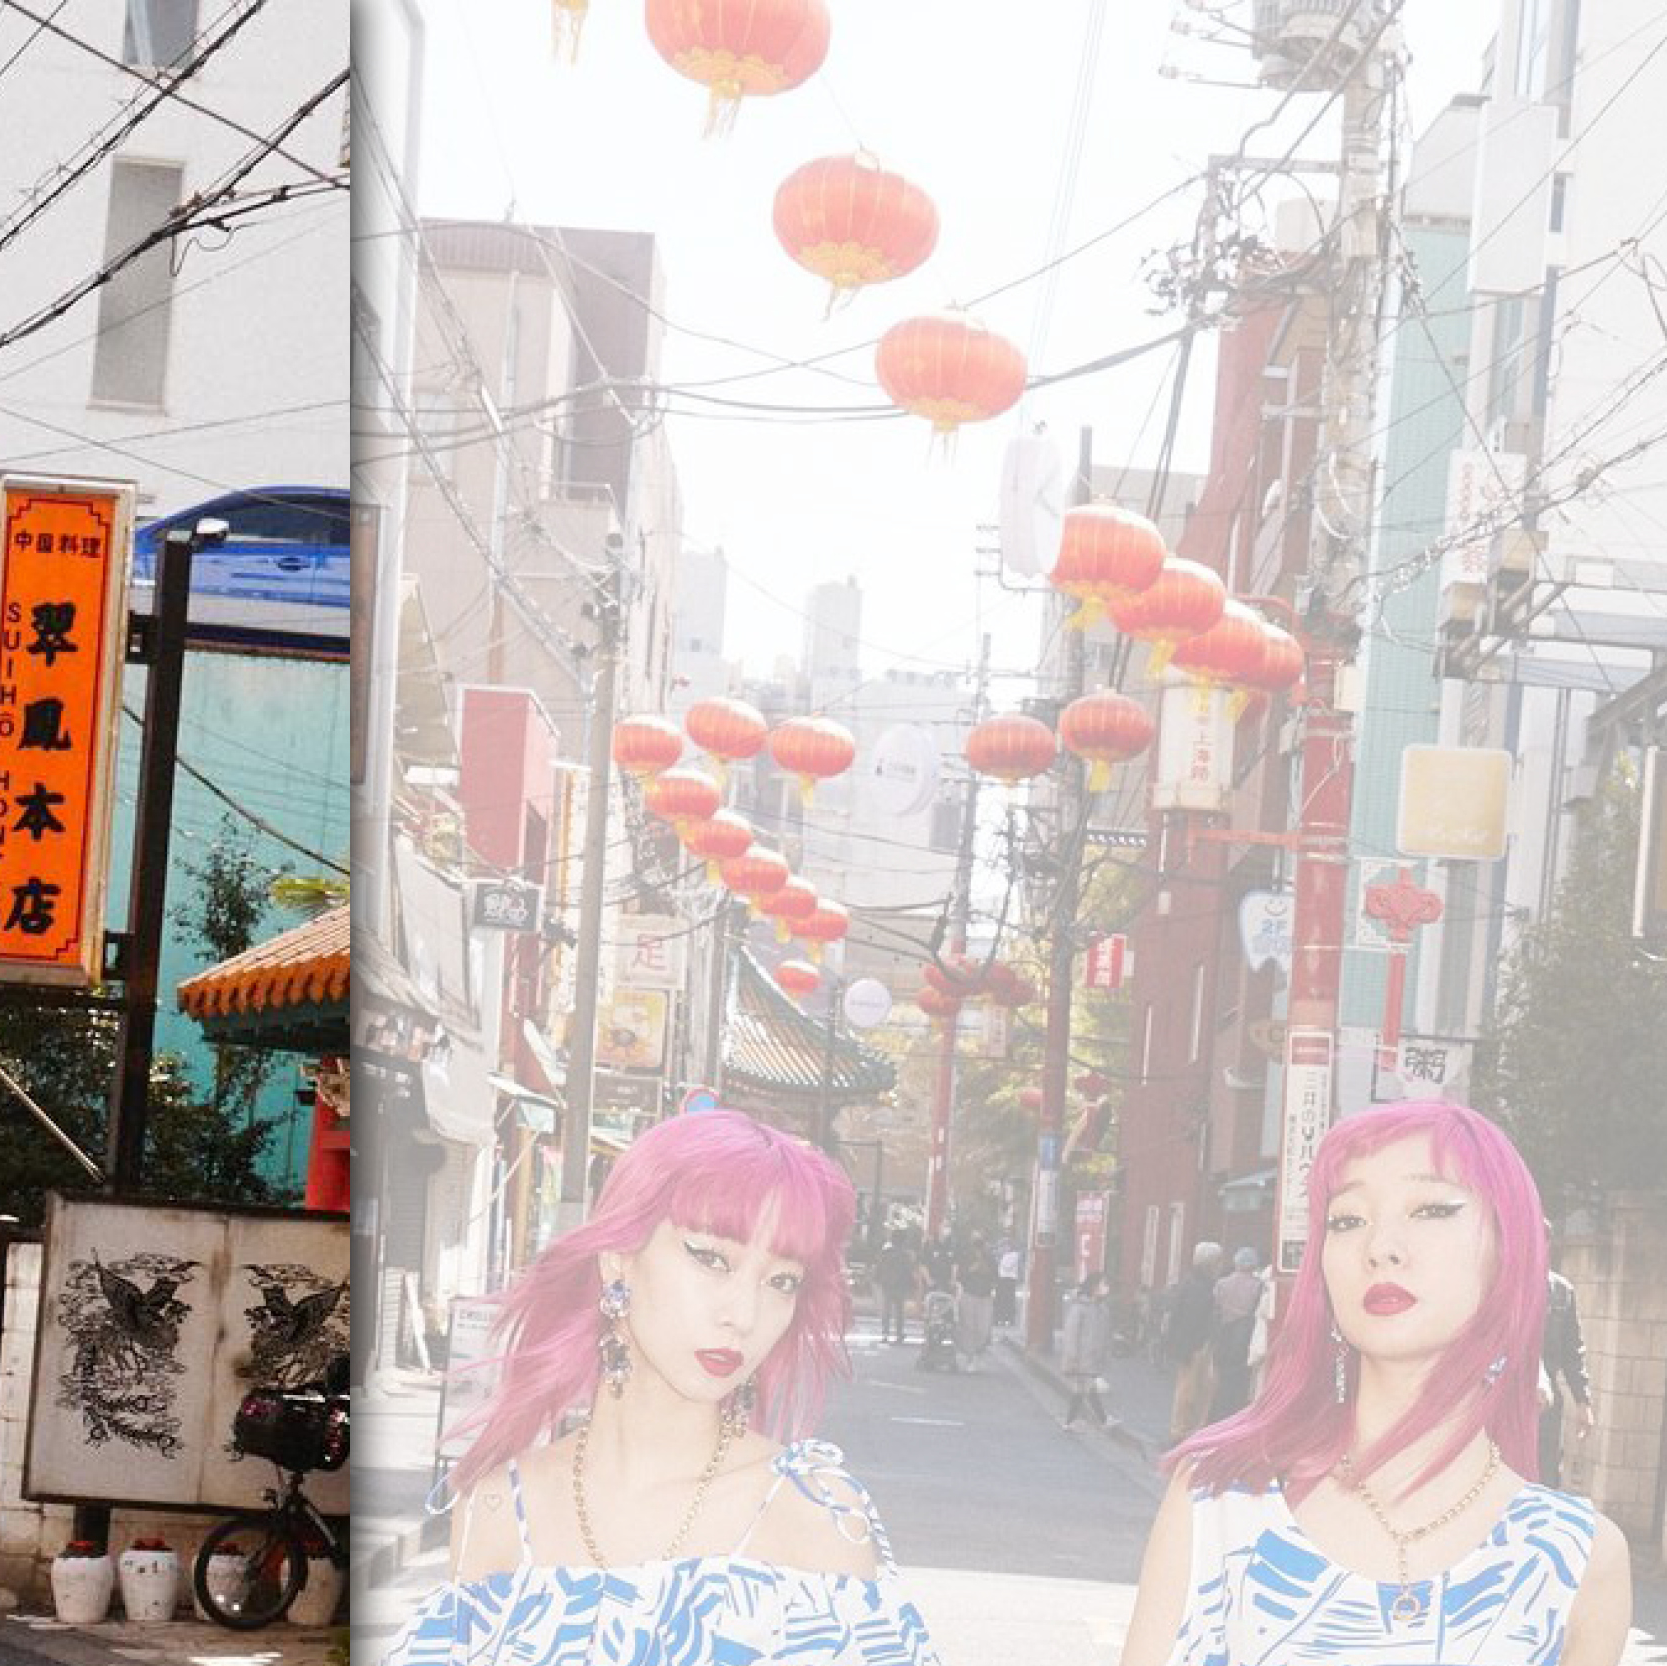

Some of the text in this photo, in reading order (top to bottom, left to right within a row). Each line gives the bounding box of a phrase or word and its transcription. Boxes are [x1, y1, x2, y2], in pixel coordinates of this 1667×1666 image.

[14, 529, 102, 560] 中国料理
[3, 602, 79, 936] 翠鳳本店
